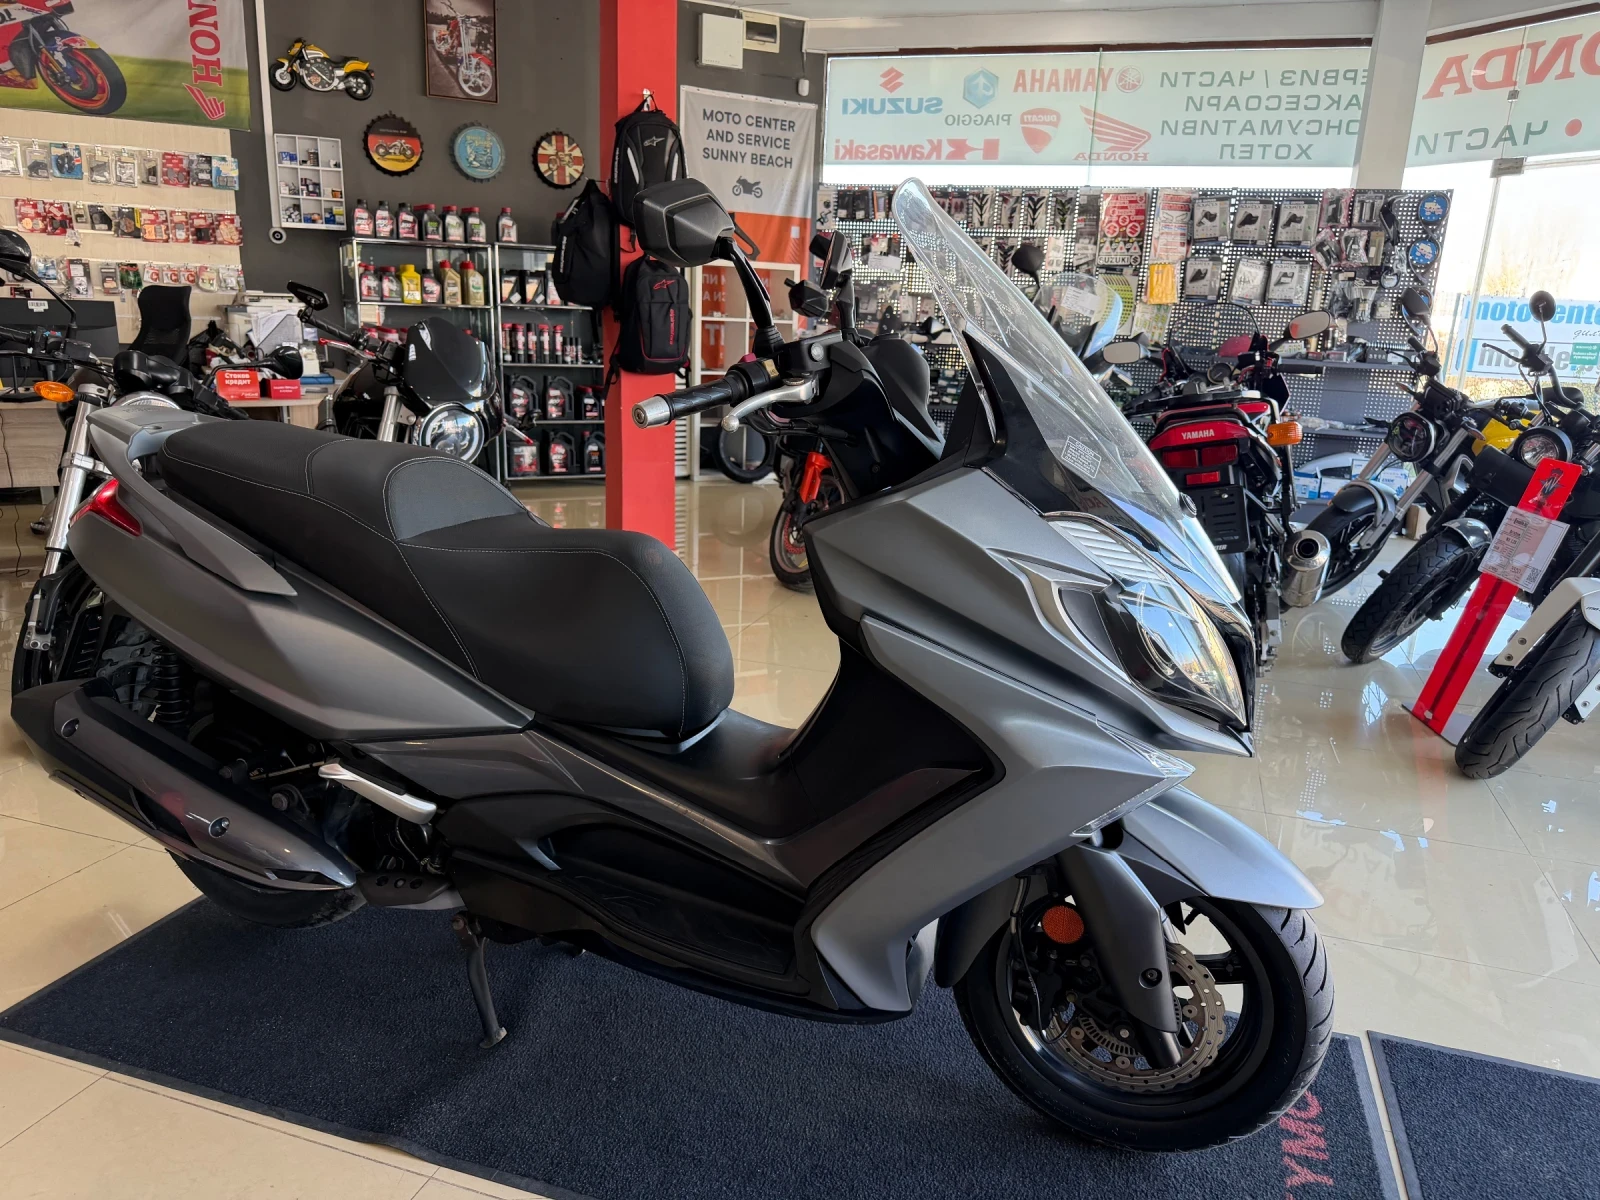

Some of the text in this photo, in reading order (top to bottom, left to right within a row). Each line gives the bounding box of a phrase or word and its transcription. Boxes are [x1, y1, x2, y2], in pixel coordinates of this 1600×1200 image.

[187, 0, 223, 87] HON
[703, 108, 796, 132] MOTO CENTER
[706, 129, 790, 150] AND SERVICE
[702, 147, 793, 169] SUNNY BEACH
[1181, 429, 1215, 440] YAMAHA
[1280, 1090, 1334, 1200] YMC
